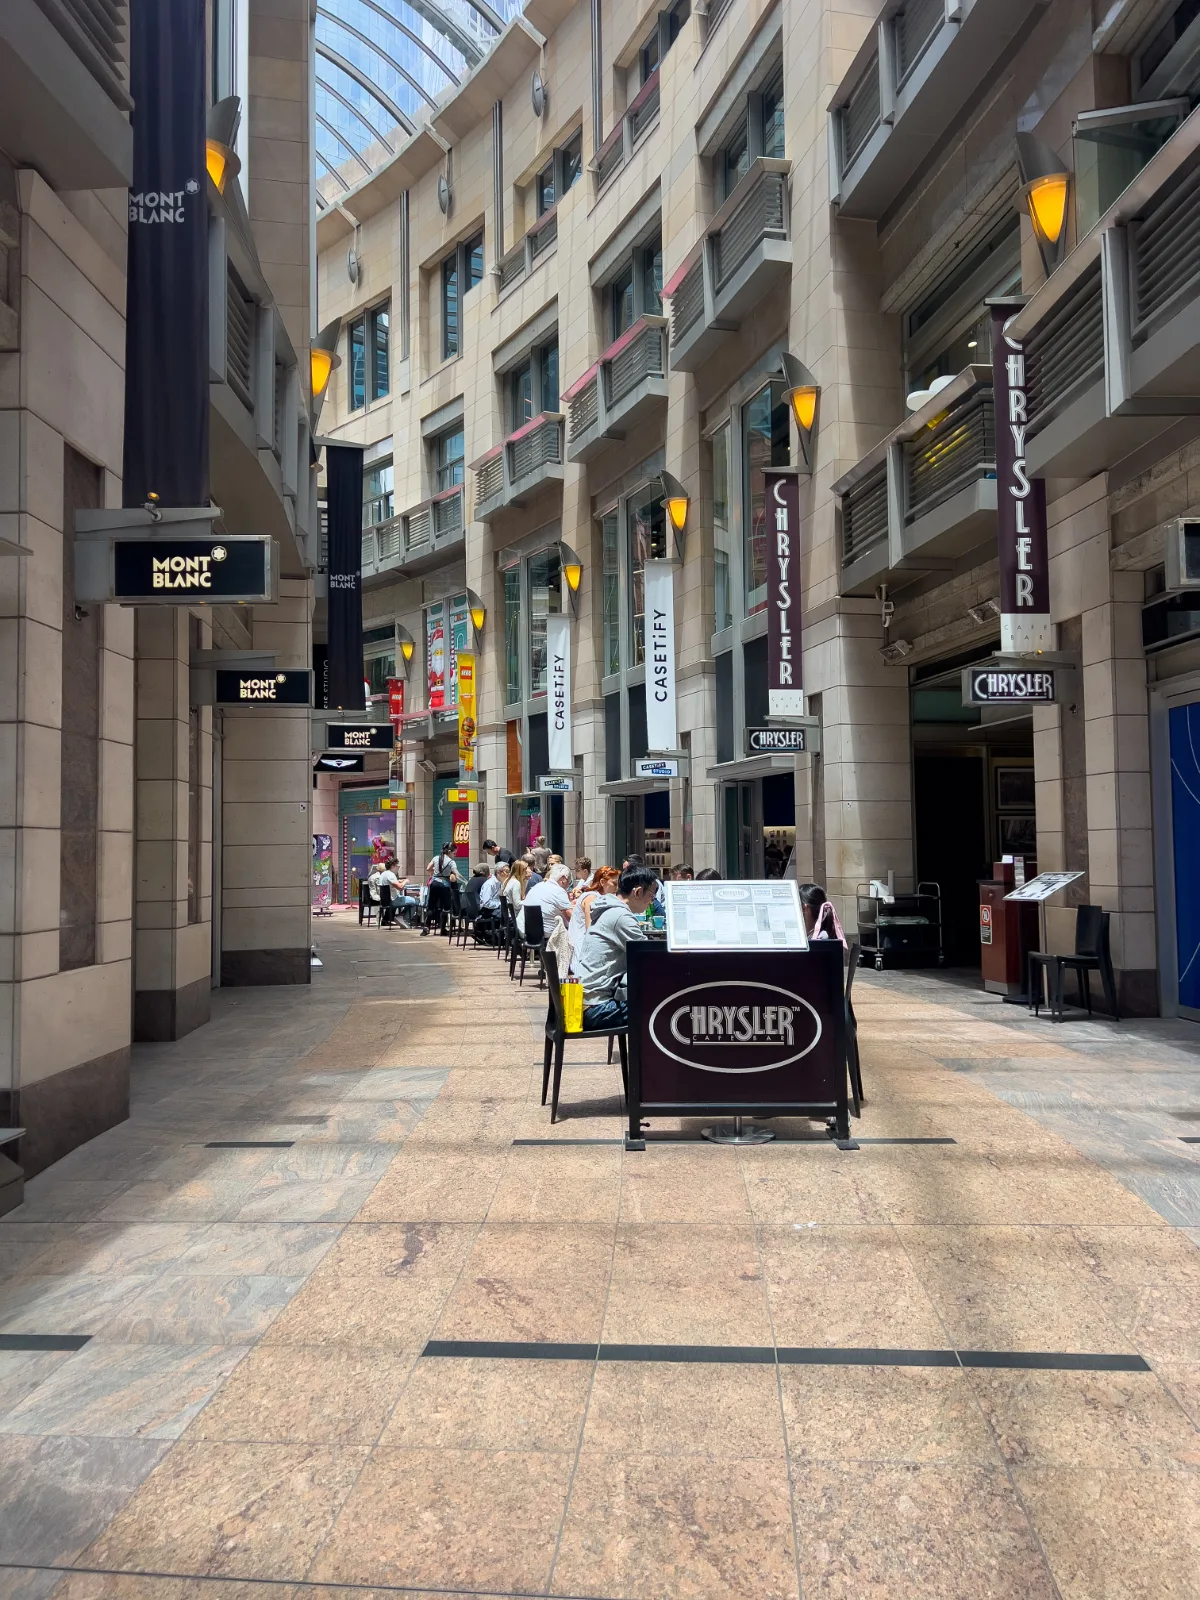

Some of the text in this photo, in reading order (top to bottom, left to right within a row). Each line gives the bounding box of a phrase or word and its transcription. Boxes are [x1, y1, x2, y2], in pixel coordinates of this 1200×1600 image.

[128, 191, 185, 207] MONT
[128, 206, 185, 223] BLANC
[152, 556, 211, 572] MONT
[152, 572, 212, 588] BLANC
[330, 574, 355, 582] MONT
[330, 581, 356, 589] BLANC
[773, 479, 793, 685] CHRYSLER
[240, 679, 276, 689] MONT
[974, 673, 1052, 699] CHRYSLER
[240, 689, 276, 699] BLANC
[344, 731, 370, 739] MONT
[344, 738, 371, 746] BLANC
[750, 731, 803, 750] CHRYSLER
[454, 824, 469, 841] LEG
[670, 1005, 794, 1045] CHRYSLER
